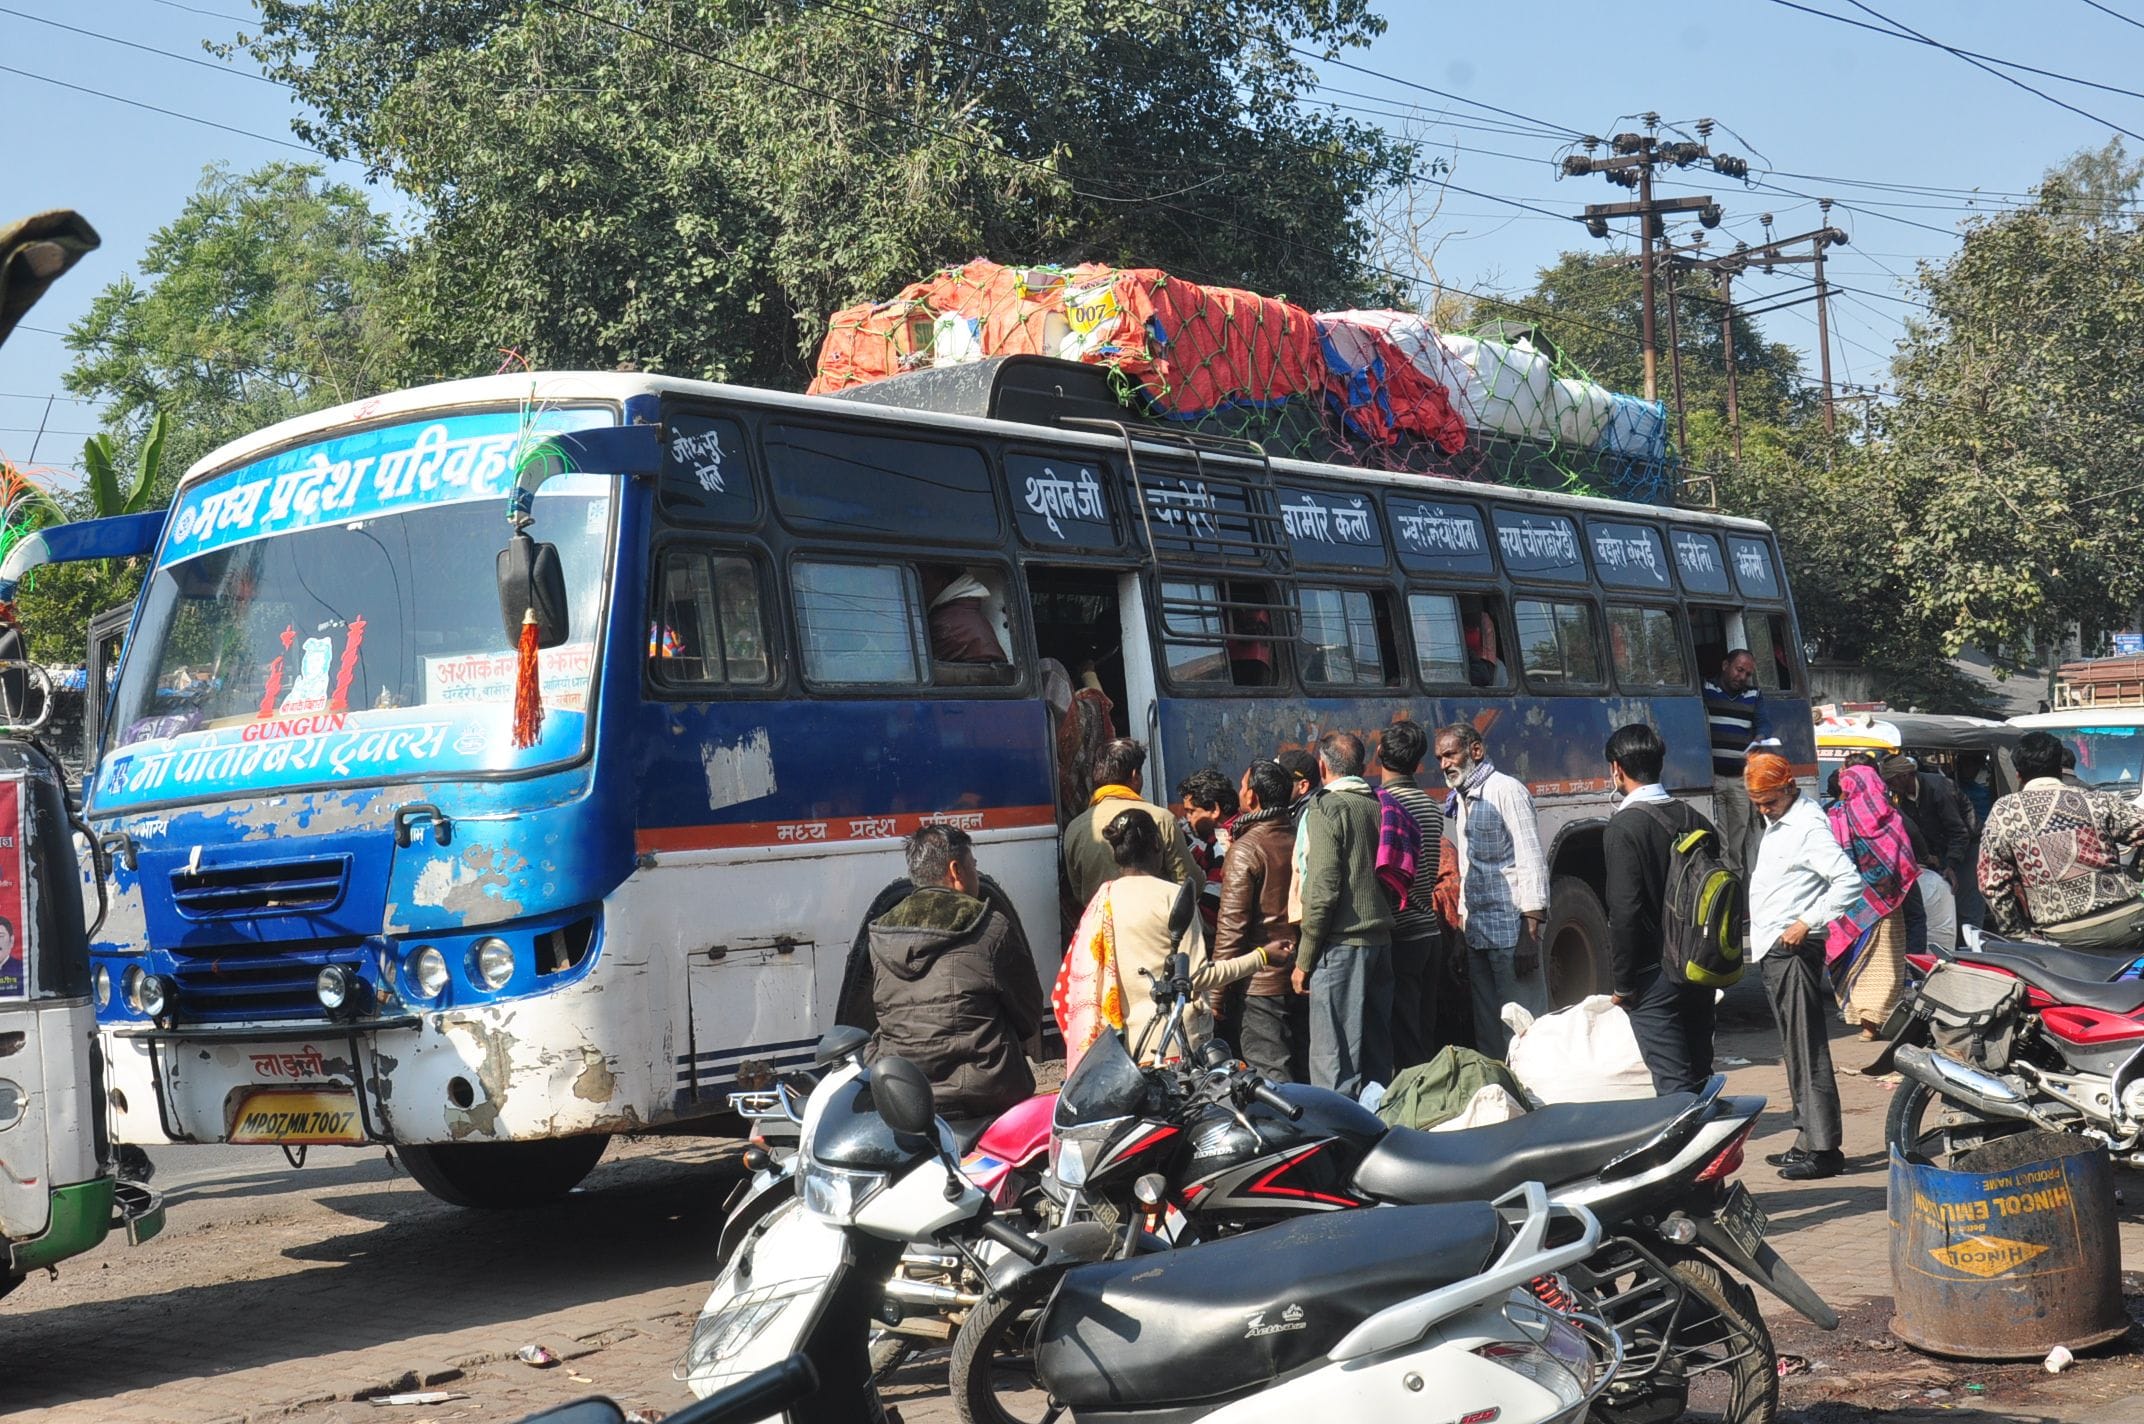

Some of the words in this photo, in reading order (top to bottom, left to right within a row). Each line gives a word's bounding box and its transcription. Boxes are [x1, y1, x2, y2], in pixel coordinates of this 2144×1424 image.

[1076, 304, 1106, 323] 007
[192, 477, 273, 542] मध्य
[260, 452, 376, 526] प्रदेश
[373, 423, 520, 501] परिवह
[242, 712, 348, 742] GUNGUN
[776, 822, 828, 841] मध्य
[849, 816, 896, 839] प्रदेश
[1193, 1146, 1234, 1160] HONDA
[1982, 1176, 2013, 1192] NAME
[2016, 1168, 2061, 1186] PRODUCT
[1992, 1186, 2070, 1217] HINCOL
